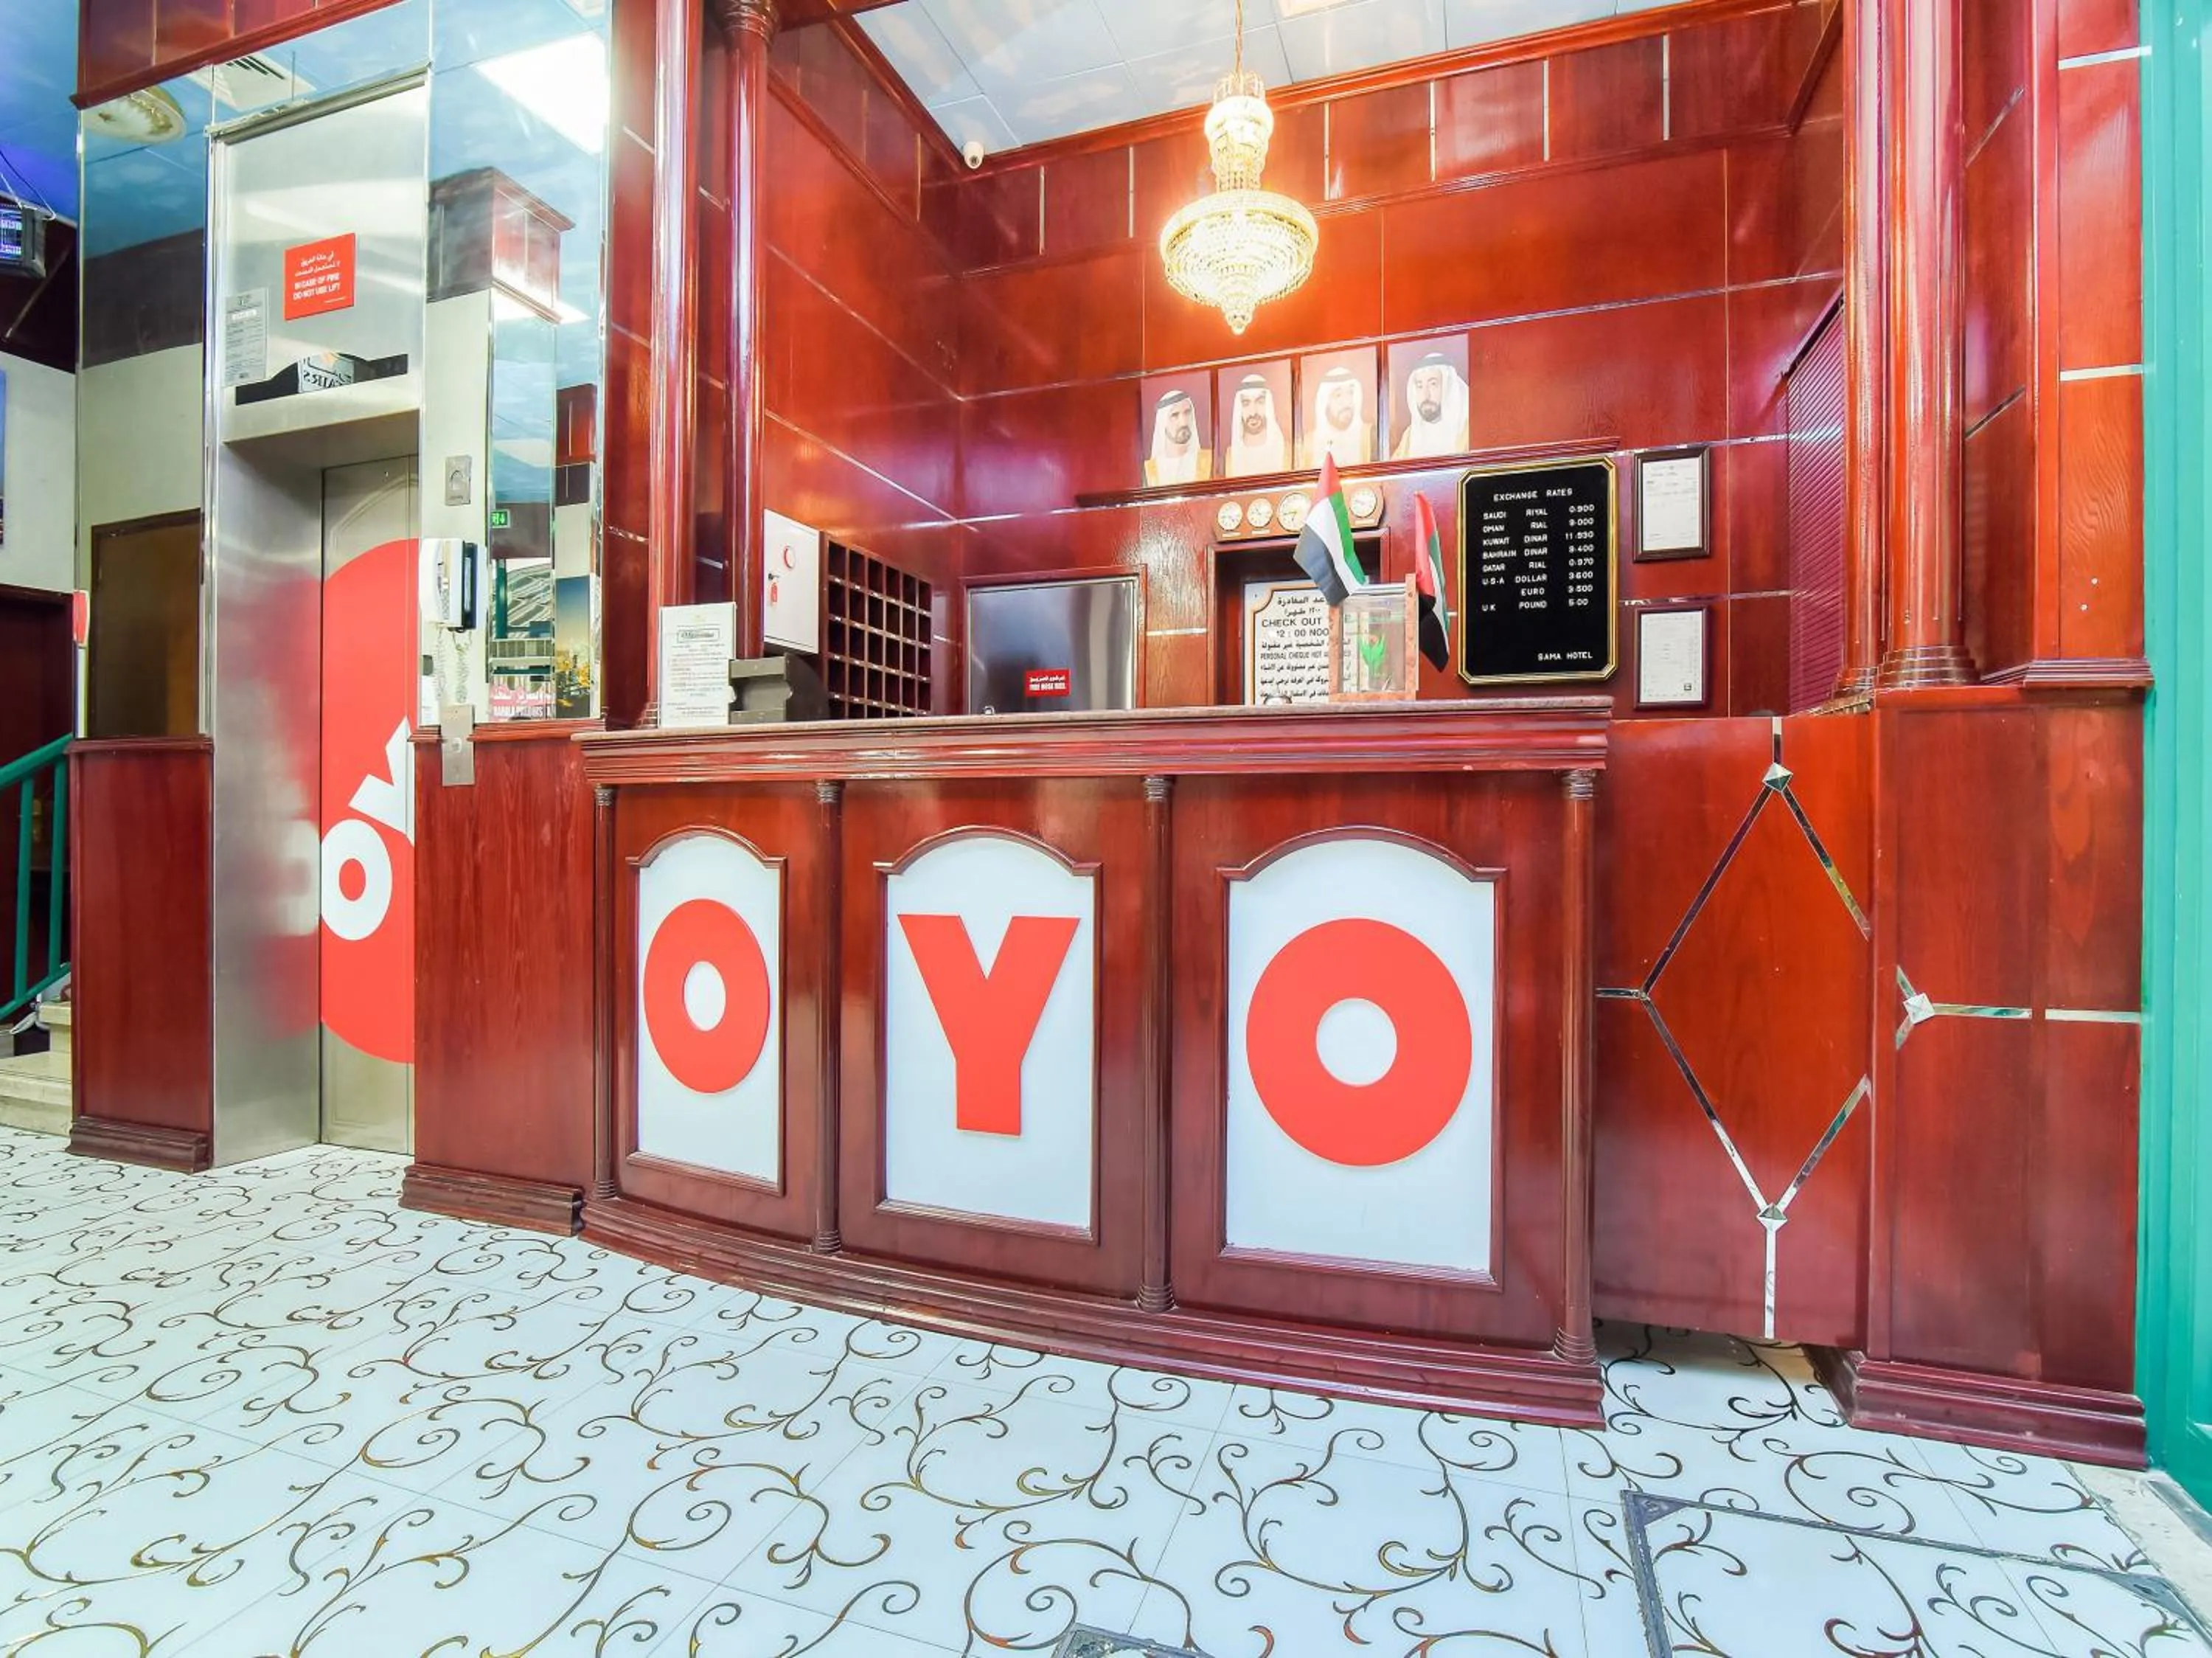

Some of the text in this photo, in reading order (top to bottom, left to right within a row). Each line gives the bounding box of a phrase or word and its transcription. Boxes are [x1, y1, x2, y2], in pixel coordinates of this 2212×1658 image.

[318, 275, 326, 284] OF
[327, 273, 340, 282] FIRE
[316, 285, 327, 295] USE
[328, 282, 340, 293] LIFT
[1493, 488, 1573, 502] EXCHANGE RATES
[1483, 510, 1506, 520] SAUDI
[1526, 508, 1548, 517] RIYAL
[1483, 524, 1505, 533] OMAN
[1483, 536, 1510, 547] KUWAIT
[1523, 533, 1548, 544] DINAR
[1483, 549, 1517, 560] BAHRAIN
[1523, 547, 1548, 557] DINAR
[1483, 563, 1506, 572] QATAR
[1514, 573, 1548, 583] DOLLAR
[1521, 587, 1545, 597] EURO
[1518, 600, 1548, 609] POUND
[1262, 617, 1321, 627] CHECK OUT
[1310, 628, 1329, 637] NOO
[1261, 652, 1287, 660] PERSONAL
[1537, 651, 1593, 662] SAMA HOTEL
